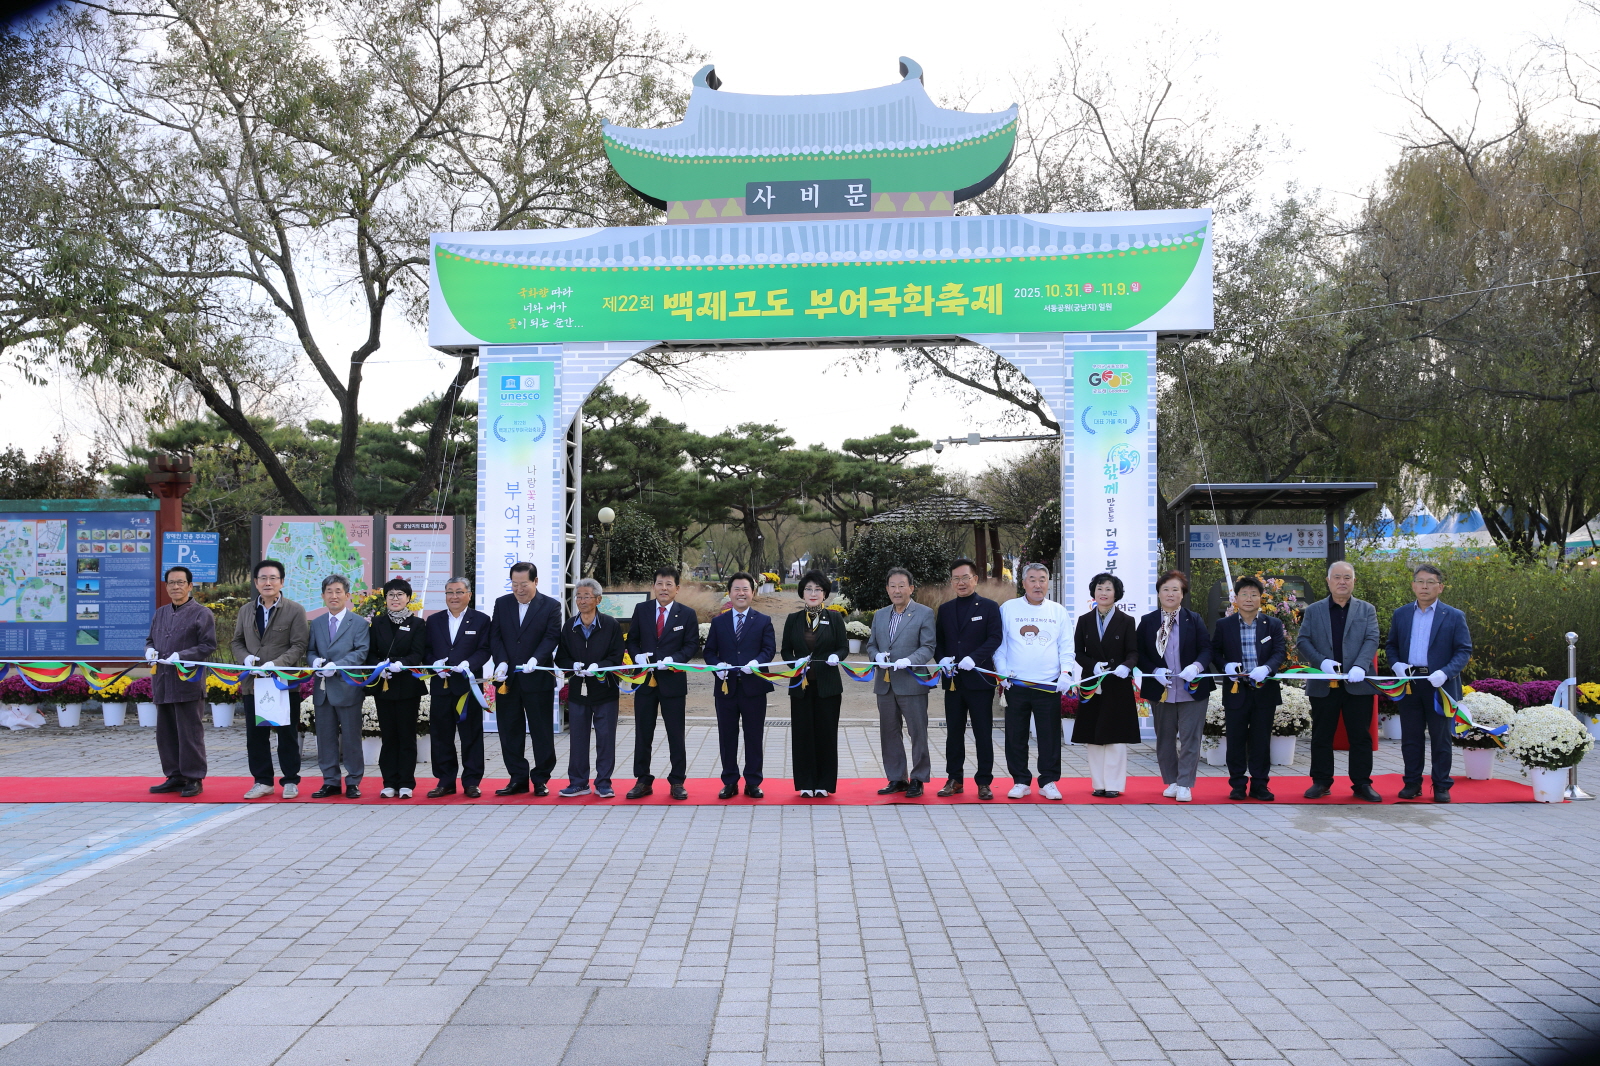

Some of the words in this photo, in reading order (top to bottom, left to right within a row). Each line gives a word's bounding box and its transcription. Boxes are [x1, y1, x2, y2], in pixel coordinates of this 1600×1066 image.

[517, 287, 549, 299] 국화향
[551, 286, 574, 298] 따라
[1014, 288, 1043, 299] 2025.
[1083, 283, 1093, 293] 금
[1131, 282, 1140, 292] 일
[523, 302, 543, 314] 너와
[546, 302, 567, 313] 내가
[602, 294, 654, 313] 제22회
[663, 289, 794, 322] 백제고도
[804, 282, 1003, 320] 부여국화축제
[1098, 302, 1113, 312] 일원
[507, 318, 527, 330] 꽃이
[530, 317, 550, 329] 되는
[1103, 463, 1119, 494] 함께
[350, 529, 370, 538] 궁남지
[1105, 528, 1117, 537] 더
[1103, 540, 1120, 557] 큰
[1262, 532, 1293, 551] 부여
[177, 544, 191, 563] P
